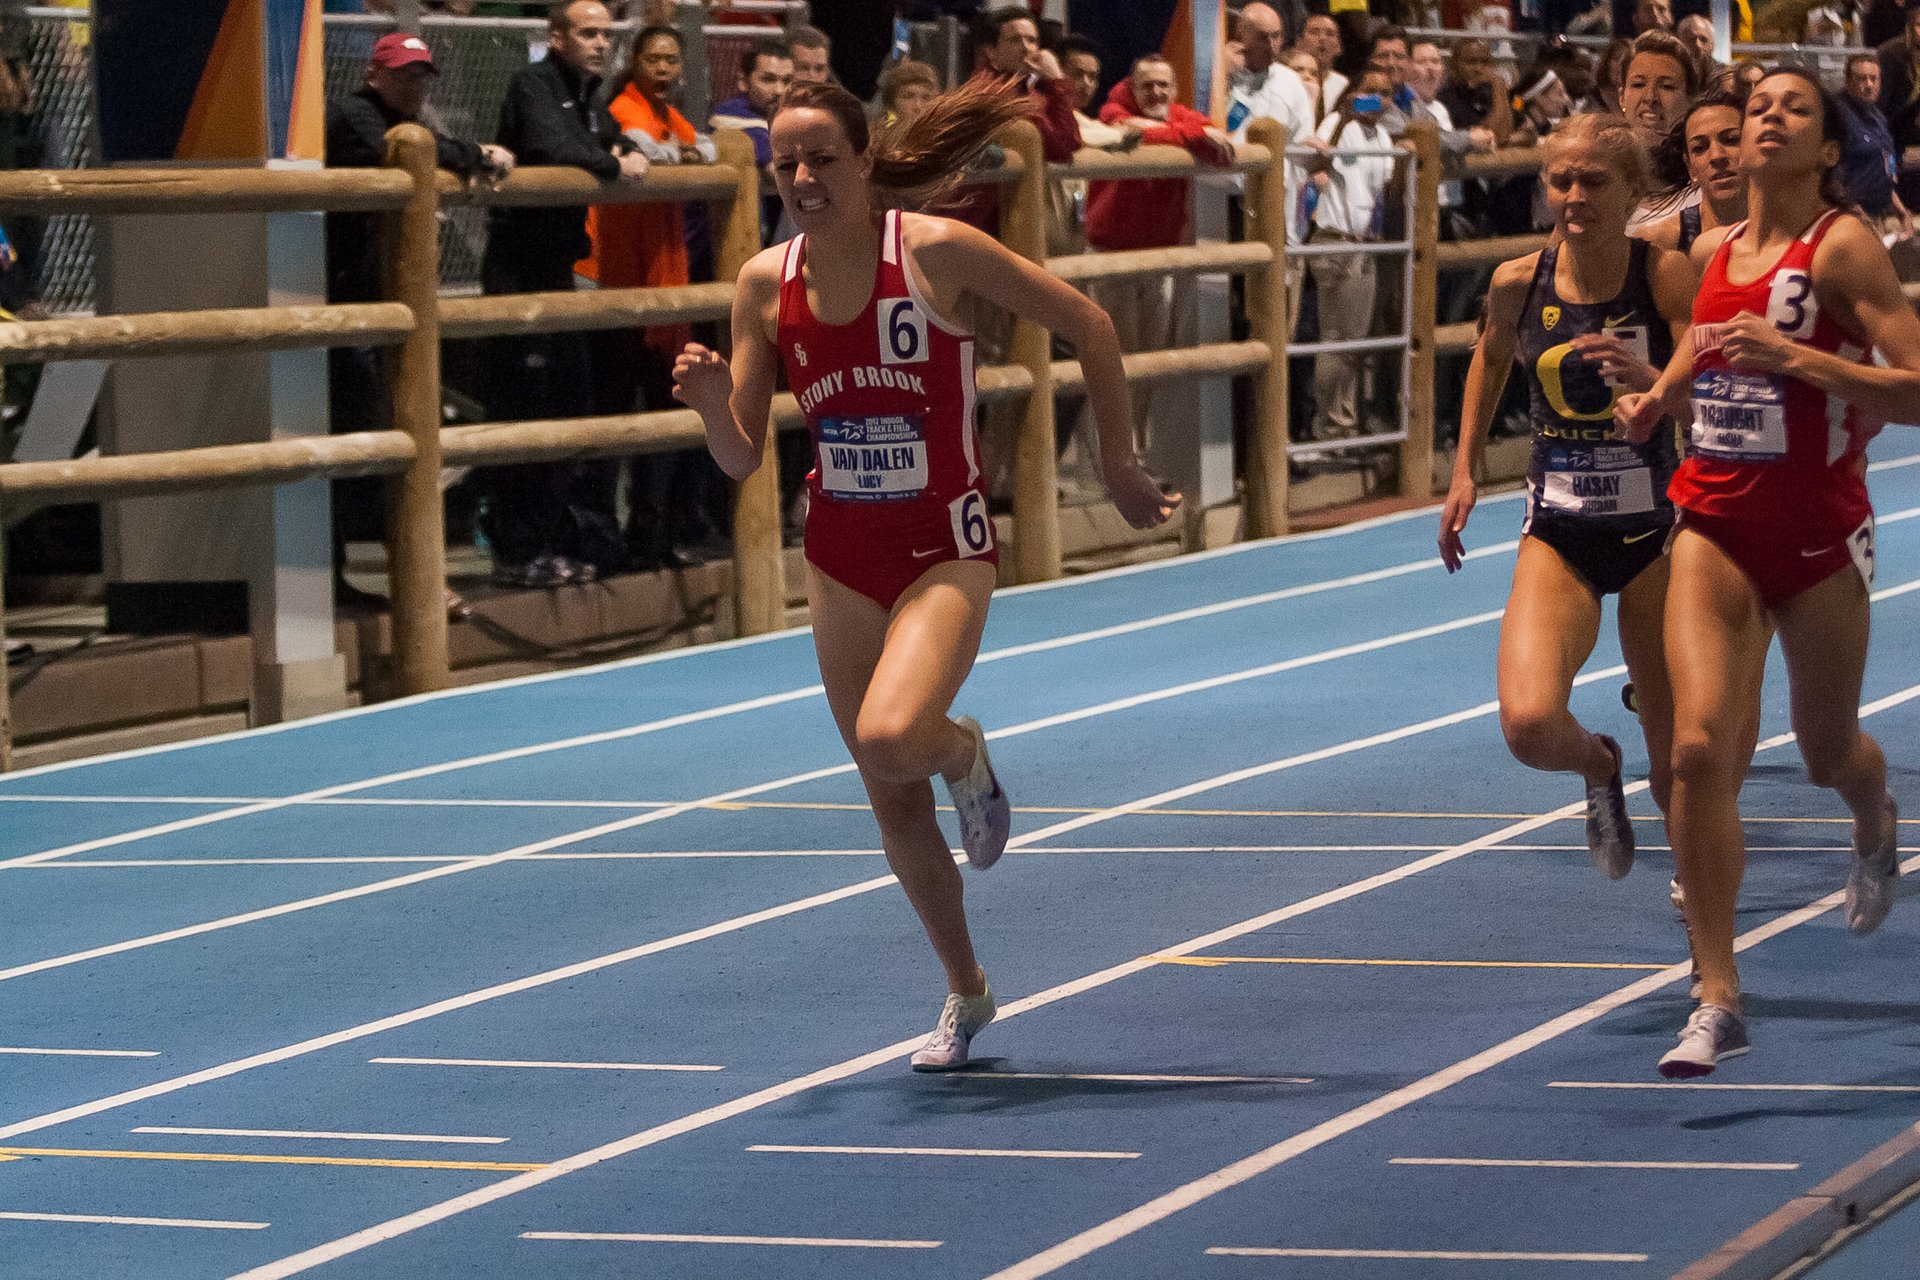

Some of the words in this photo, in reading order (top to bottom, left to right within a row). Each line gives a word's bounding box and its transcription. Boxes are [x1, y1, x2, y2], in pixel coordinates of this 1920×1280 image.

[1775, 274, 1812, 332] 3
[889, 301, 919, 360] 6
[801, 370, 843, 413] STONY
[852, 366, 926, 395] BROOK
[866, 425, 887, 433] TRACK
[893, 424, 910, 432] FIELD
[866, 431, 918, 441] CHAMPIONSHIPS
[829, 447, 857, 471] VAN
[863, 447, 915, 471] DALEN
[857, 475, 882, 489] LUCY
[1573, 475, 1620, 497] HASAY
[962, 493, 986, 552] 6
